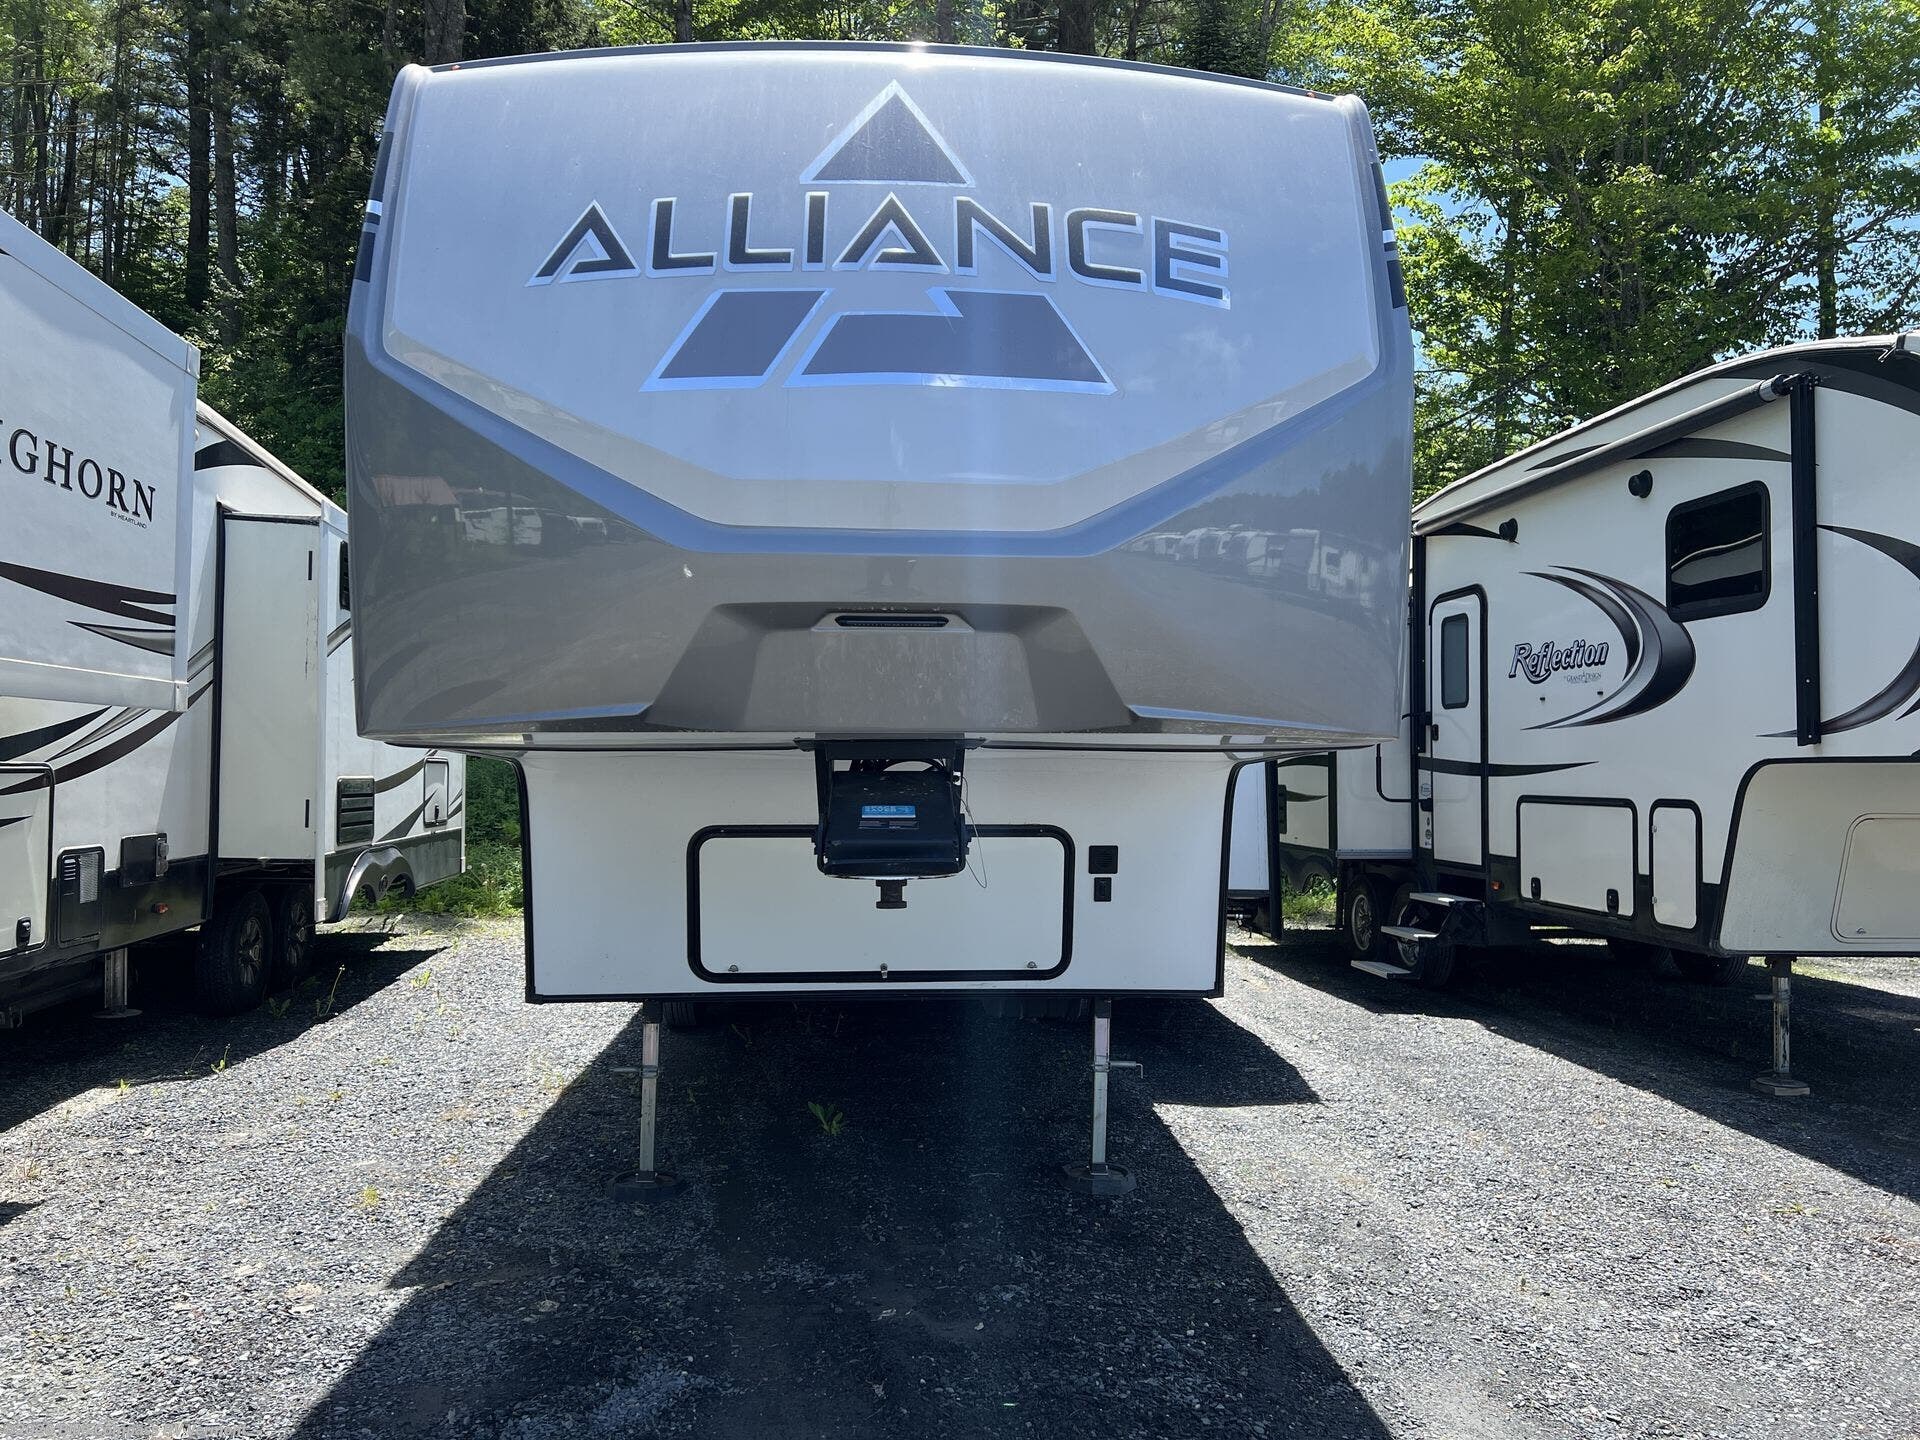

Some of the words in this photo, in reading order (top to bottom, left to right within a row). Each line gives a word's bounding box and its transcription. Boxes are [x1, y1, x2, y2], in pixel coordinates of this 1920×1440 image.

[525, 192, 1230, 309] ALLIANCE
[0, 419, 156, 522] GHORN
[1508, 639, 1610, 684] Reflection
